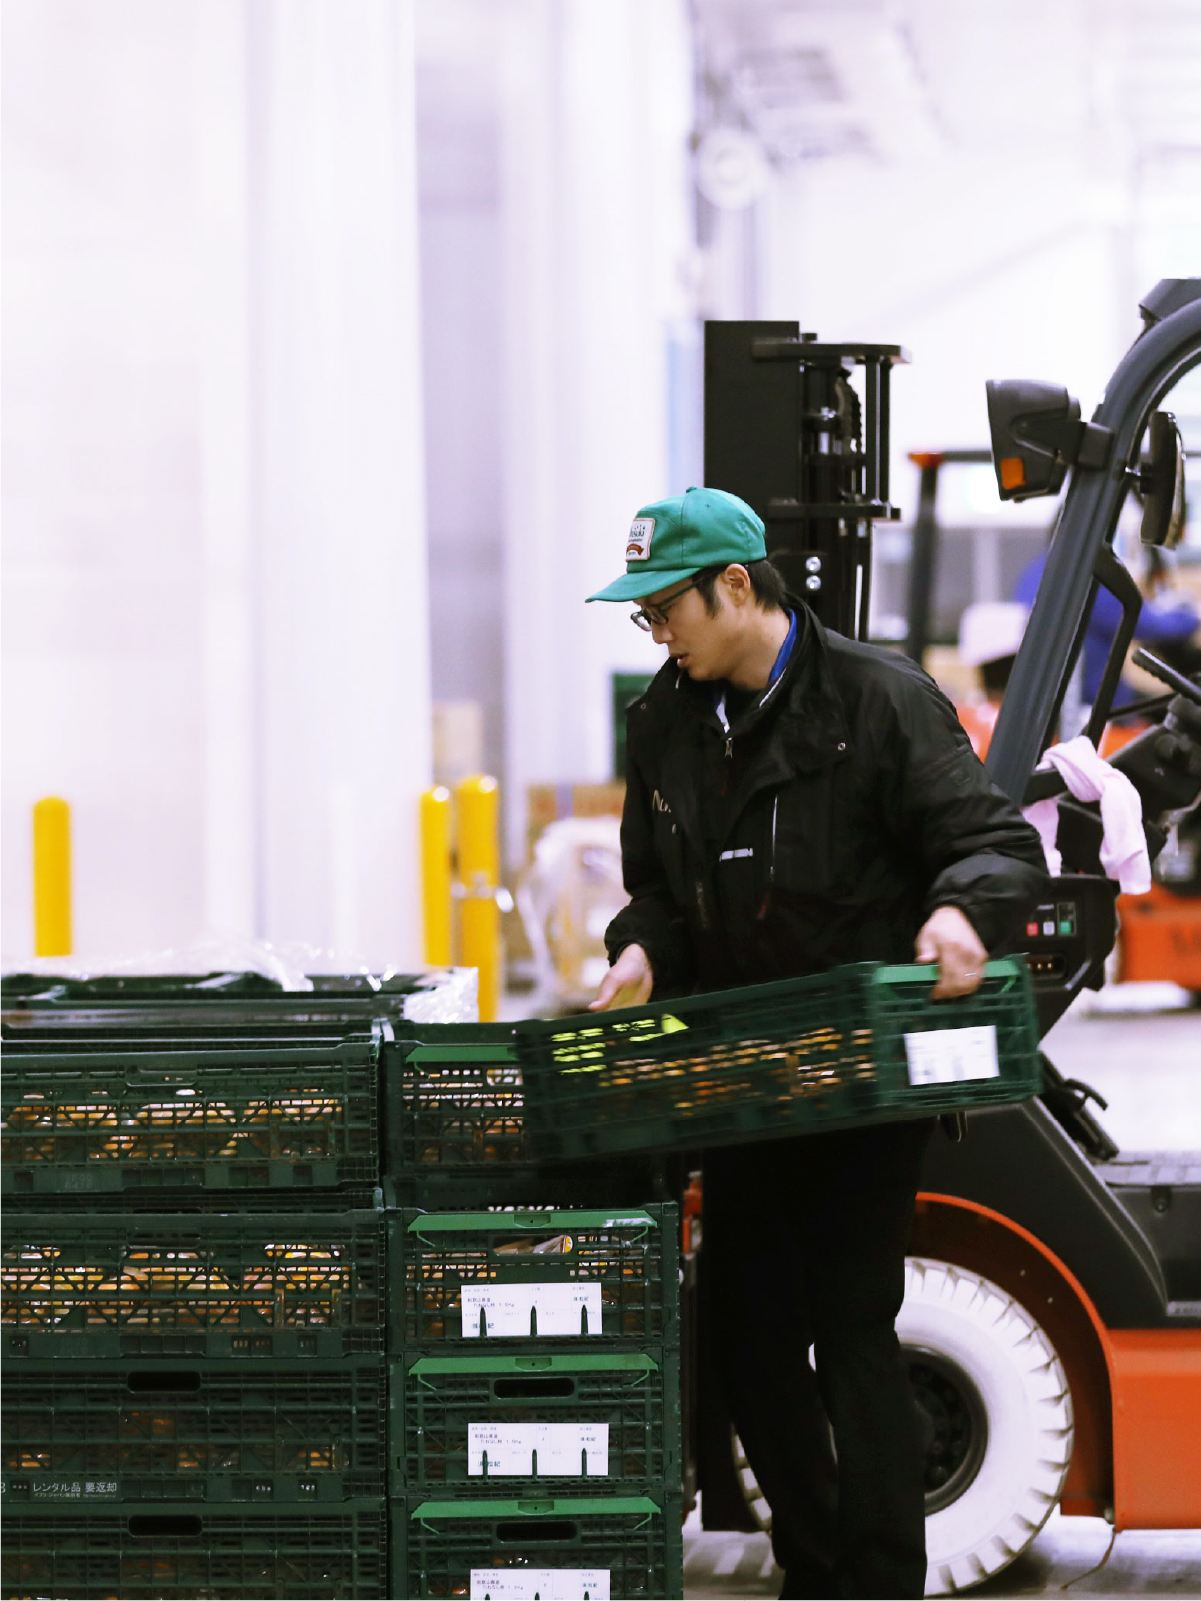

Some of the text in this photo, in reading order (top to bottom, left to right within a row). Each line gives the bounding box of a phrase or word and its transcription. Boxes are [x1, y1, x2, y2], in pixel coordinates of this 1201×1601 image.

[33, 1482, 81, 1492] レンタル品
[85, 1482, 117, 1493] 要返却
